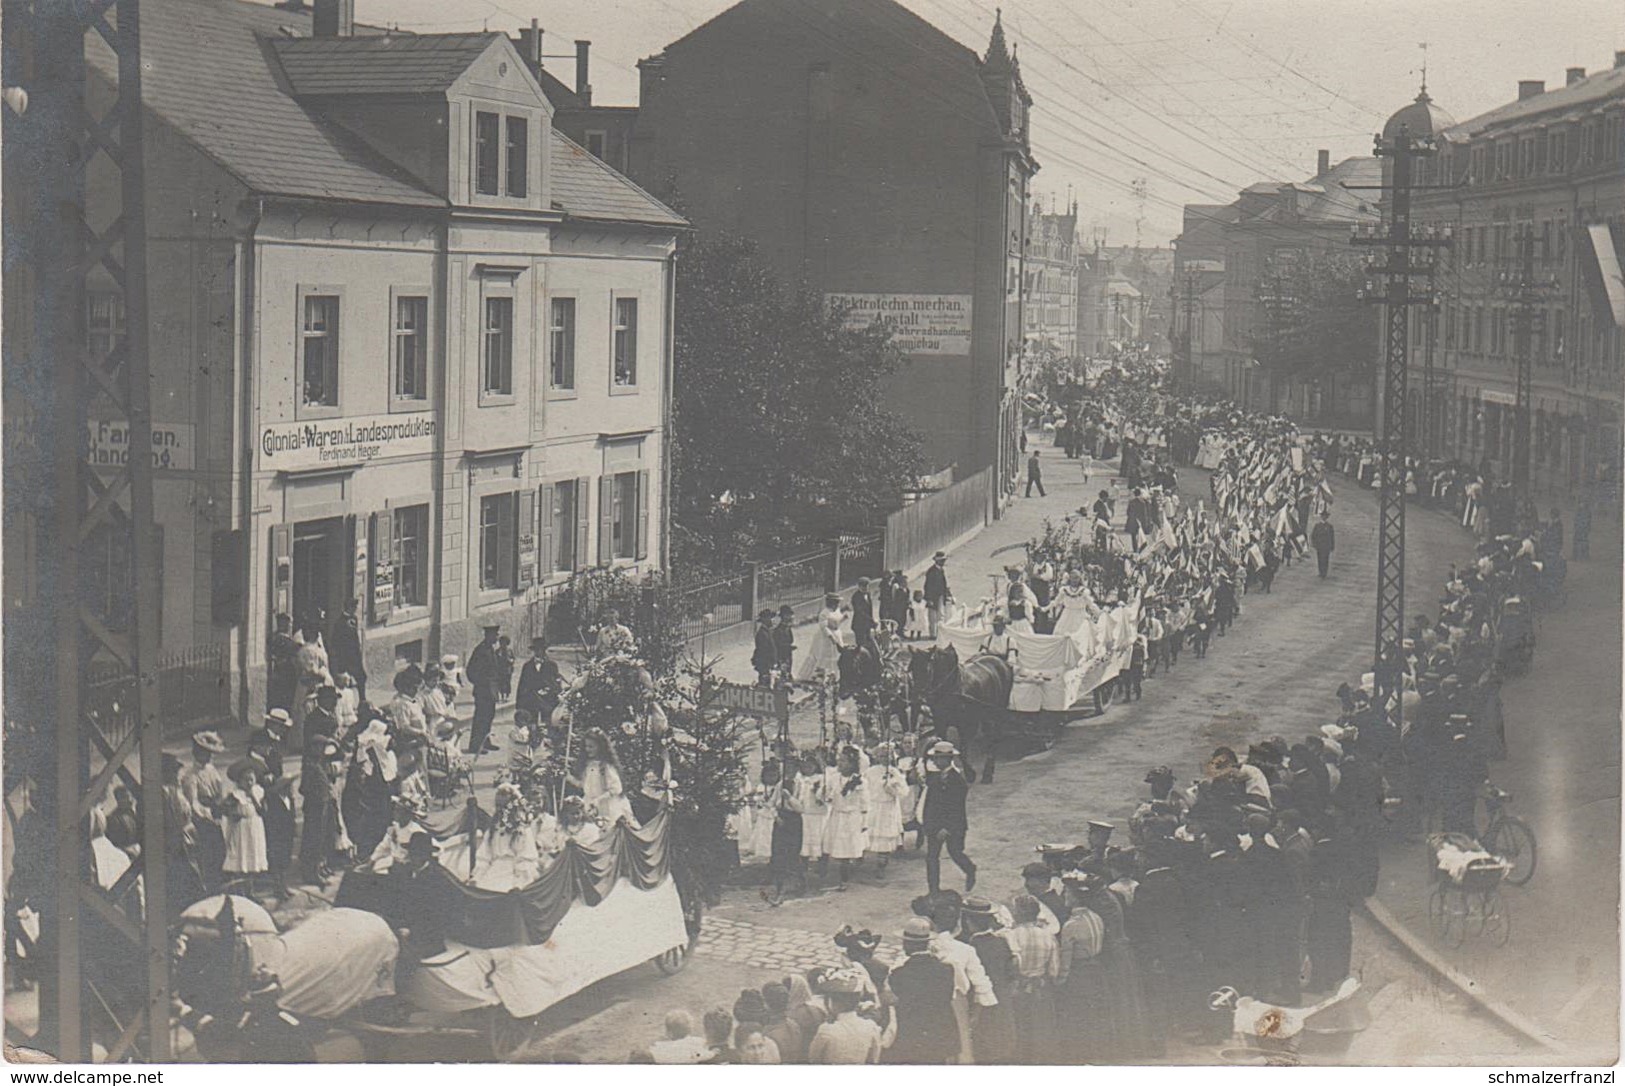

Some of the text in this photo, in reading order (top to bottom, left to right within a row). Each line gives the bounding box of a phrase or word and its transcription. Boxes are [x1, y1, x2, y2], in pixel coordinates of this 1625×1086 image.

[349, 417, 437, 444] Landesprodukten
[319, 444, 357, 461] Ferdinand
[709, 687, 776, 713] OMMER
